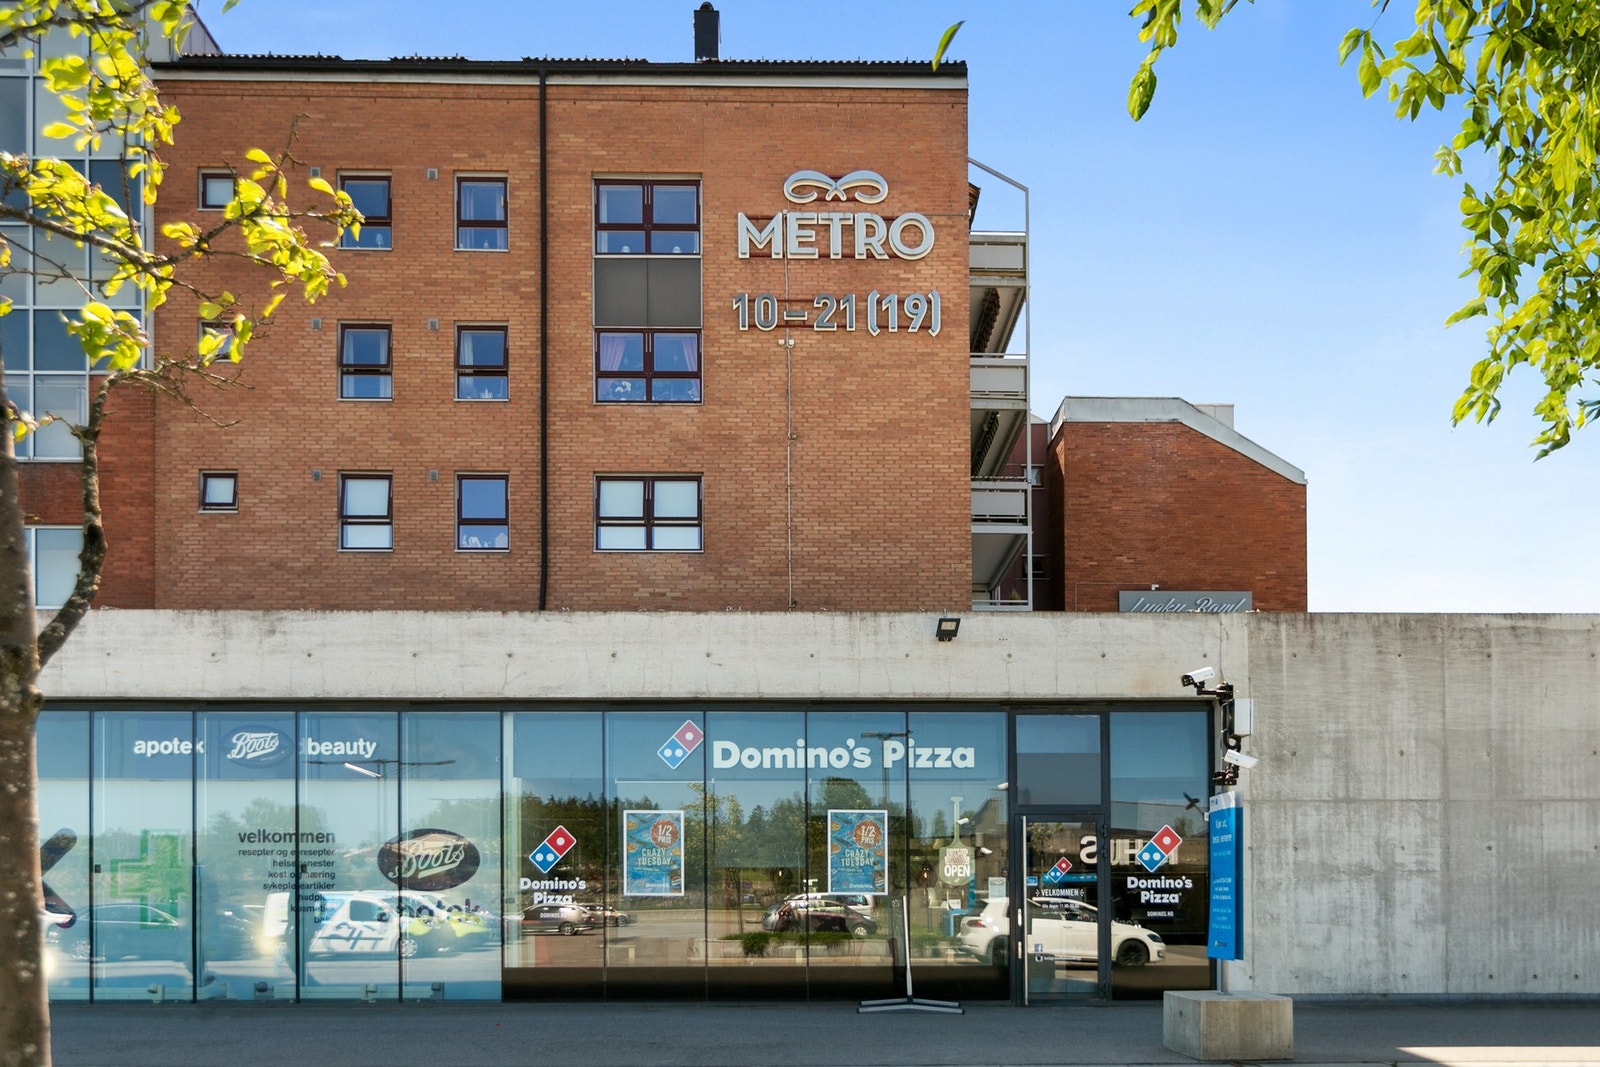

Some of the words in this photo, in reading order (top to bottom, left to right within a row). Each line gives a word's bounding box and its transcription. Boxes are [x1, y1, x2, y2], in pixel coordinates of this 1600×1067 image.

[737, 211, 935, 260] METRO
[867, 289, 941, 337] (19)
[133, 737, 205, 758] apotek
[227, 732, 280, 759] Boots
[307, 737, 377, 758] beauty
[713, 738, 872, 769] Domino's
[883, 738, 975, 769] Pizza
[238, 829, 336, 843] velkommen
[658, 825, 672, 836] 1/2
[861, 825, 875, 836] 1/2
[238, 848, 275, 857] resepter
[276, 849, 288, 857] og
[290, 848, 335, 857] eresepter
[641, 848, 666, 857] CRAZY
[845, 849, 869, 857] CRAZY
[388, 840, 466, 879] Boots
[637, 857, 672, 866] TUESDAY
[841, 857, 874, 867] TUESDAY
[944, 864, 970, 877] OPEN
[520, 876, 586, 890] Domino's
[1126, 875, 1193, 888] Domino's
[533, 891, 573, 904] Pizza
[1041, 889, 1079, 897] VELKOMMEN
[1140, 890, 1179, 903] Pizza
